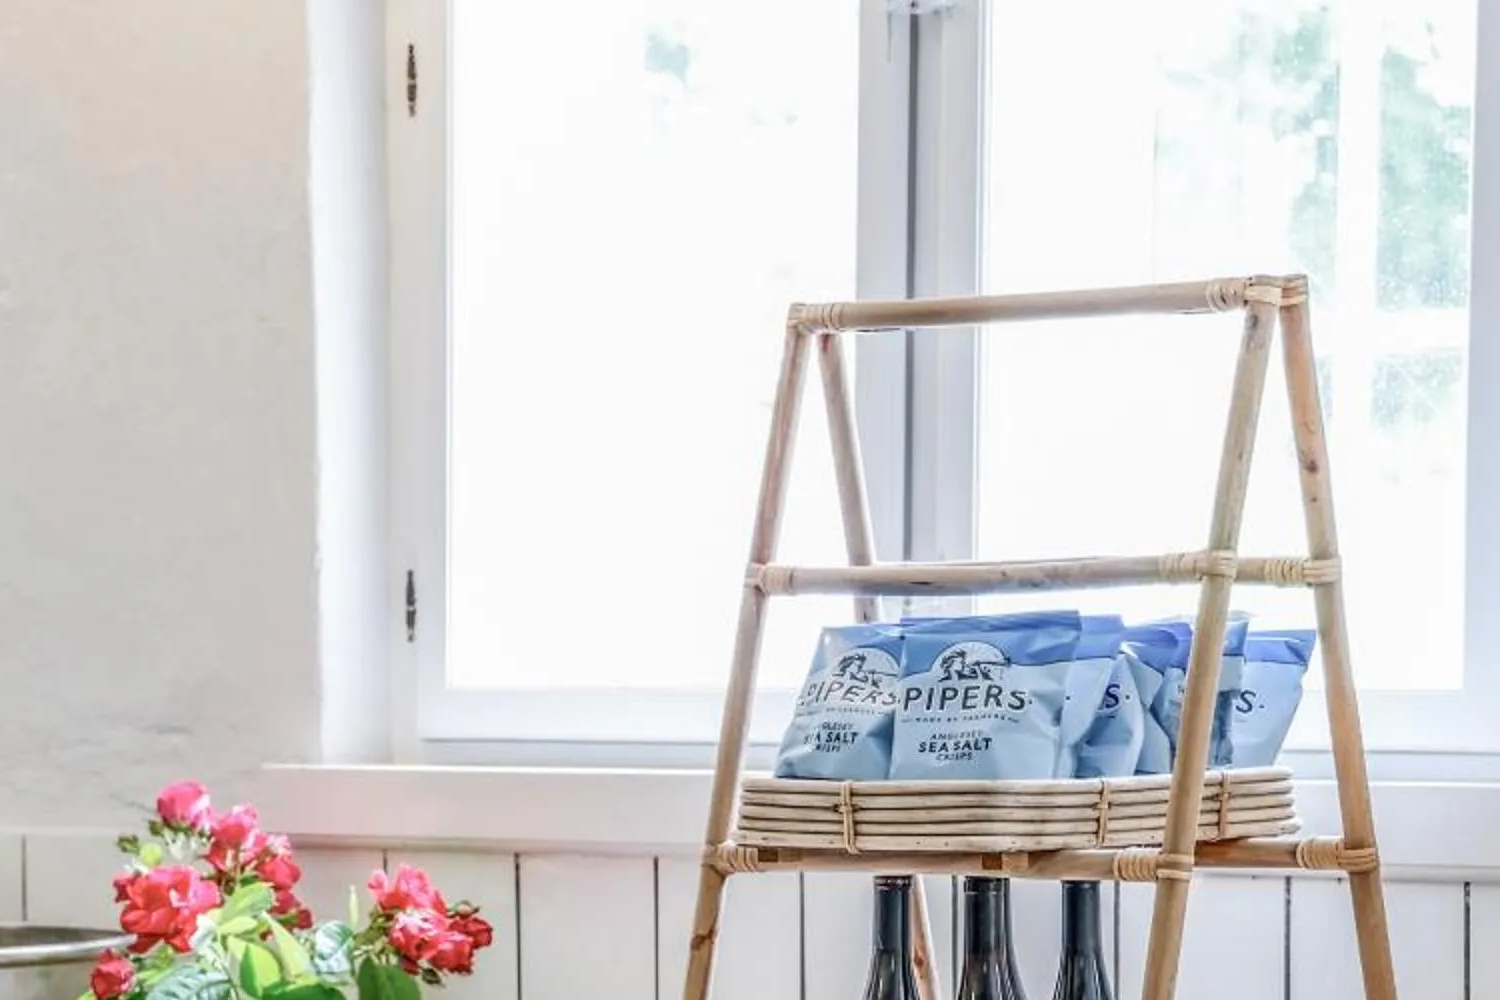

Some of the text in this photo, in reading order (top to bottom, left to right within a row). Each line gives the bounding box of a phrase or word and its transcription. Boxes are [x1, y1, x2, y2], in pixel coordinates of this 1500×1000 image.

[903, 684, 1027, 711] PIPERS
[825, 731, 859, 745] SALT
[918, 737, 994, 754] SEA SALT
